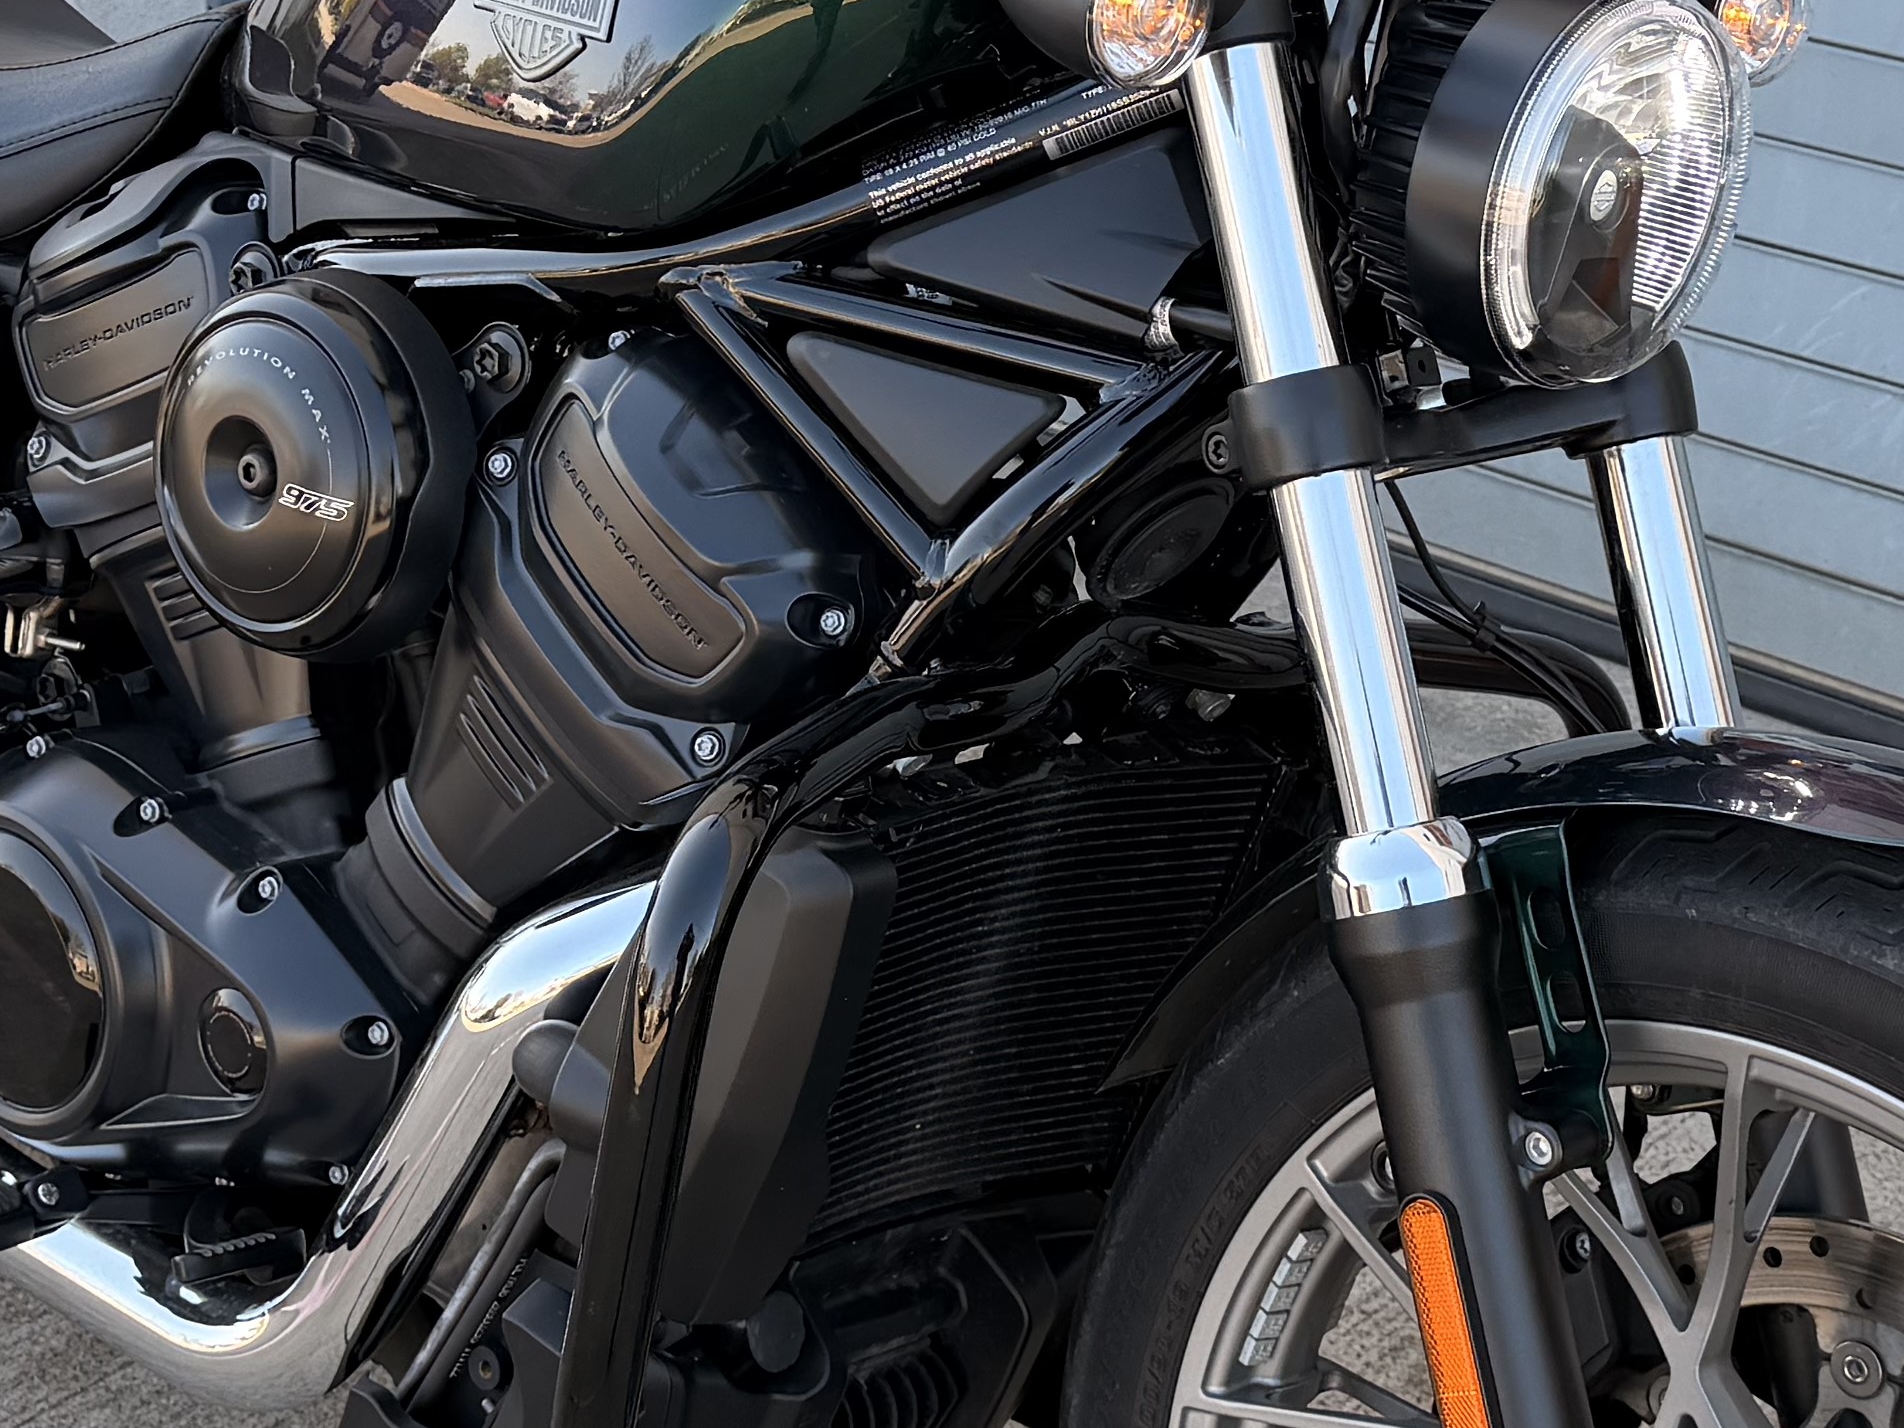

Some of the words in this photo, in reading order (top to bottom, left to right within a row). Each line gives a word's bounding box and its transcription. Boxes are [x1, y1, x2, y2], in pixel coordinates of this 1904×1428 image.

[502, 13, 564, 64] CYCLES
[187, 347, 296, 386] REVOLUTION
[278, 483, 354, 521] 975
